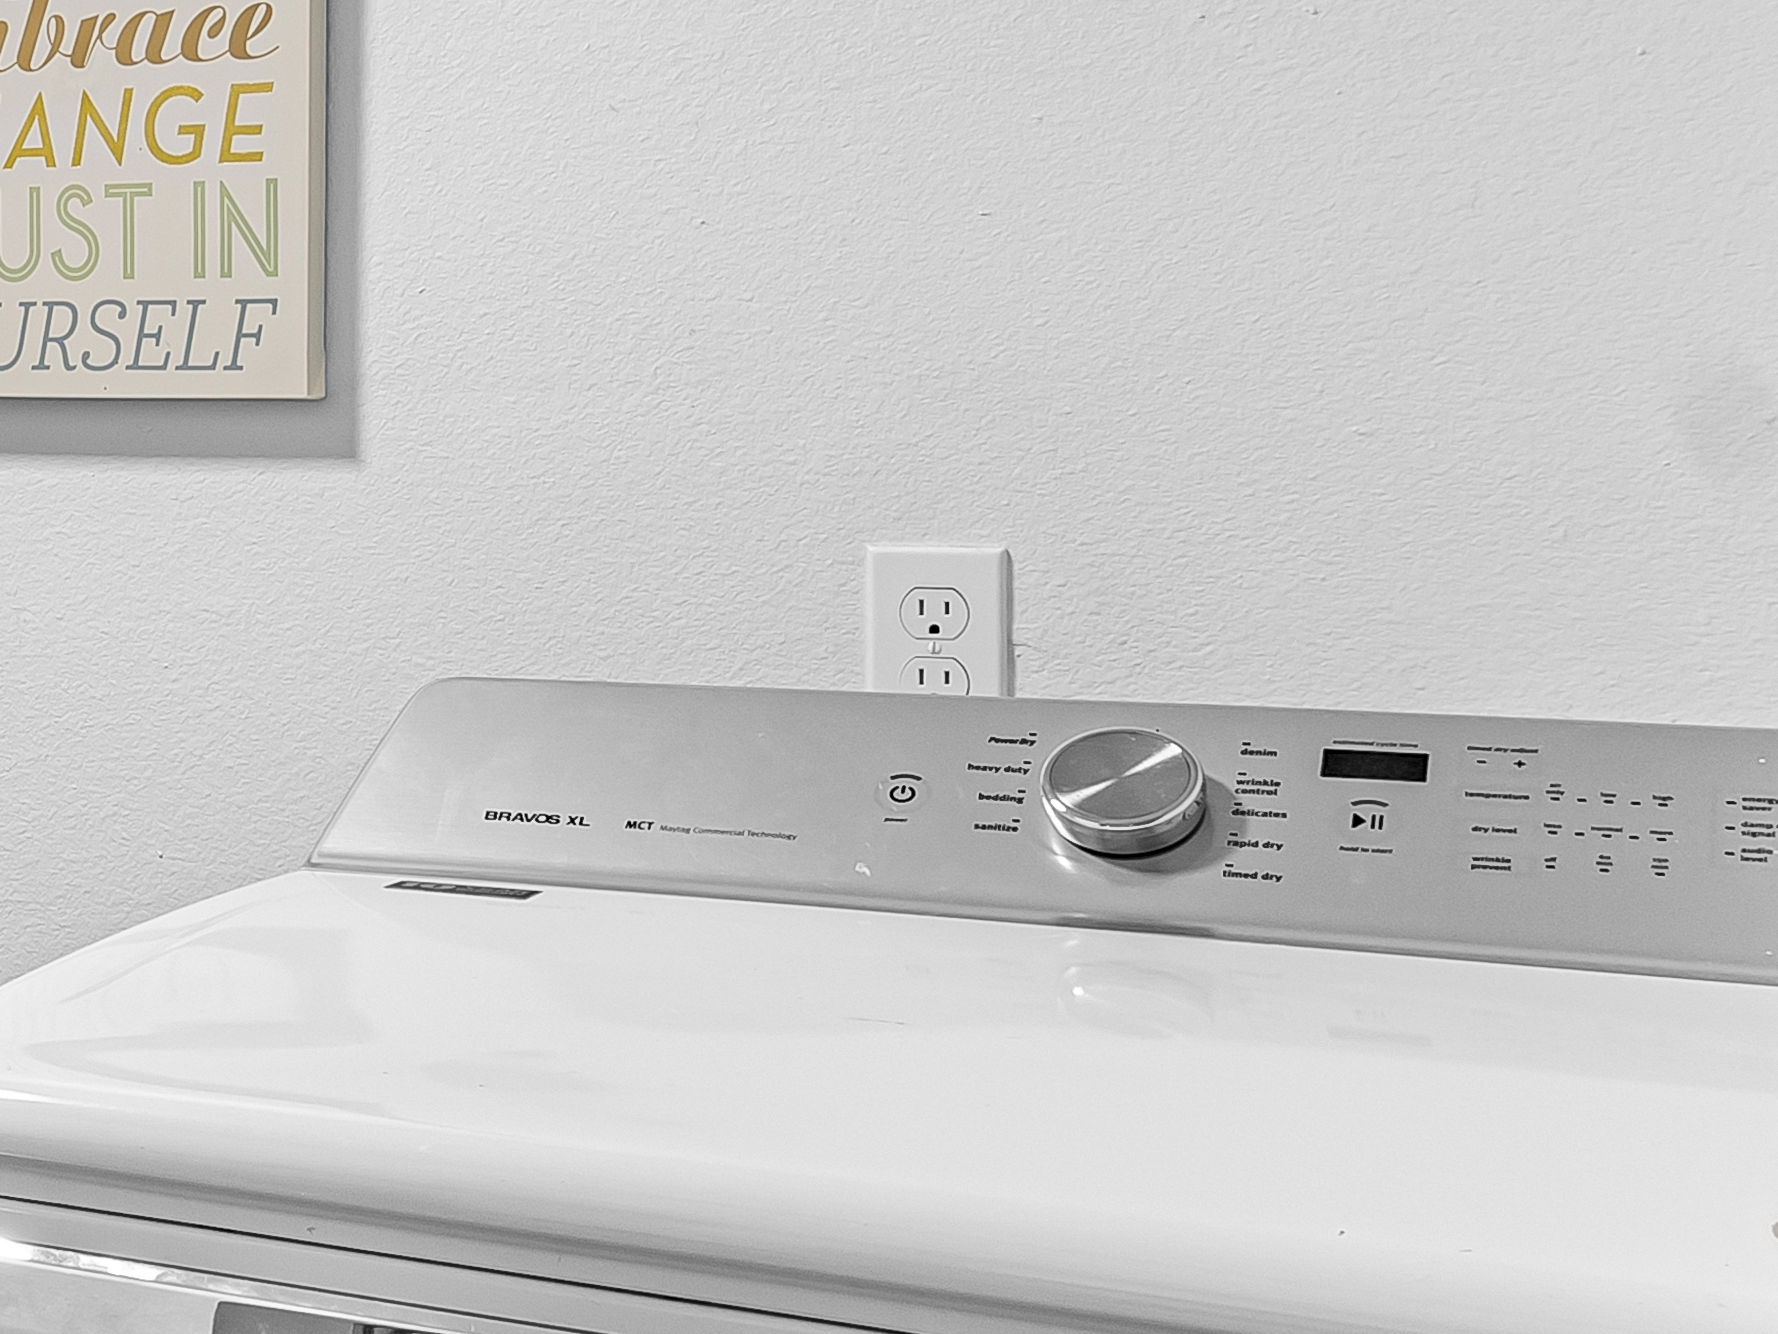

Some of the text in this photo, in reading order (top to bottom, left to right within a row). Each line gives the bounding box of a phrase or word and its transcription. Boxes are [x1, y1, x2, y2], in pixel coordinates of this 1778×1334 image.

[192, 177, 279, 279] IN
[1240, 748, 1278, 757] denim
[967, 763, 1030, 775] heavy duty
[978, 792, 1024, 805] bedding
[484, 810, 591, 827] BRAVOS XL
[625, 819, 798, 841] MCT Maytag Commercial Technology
[1226, 839, 1284, 851] rapid dry
[1222, 869, 1284, 883] timed dry
